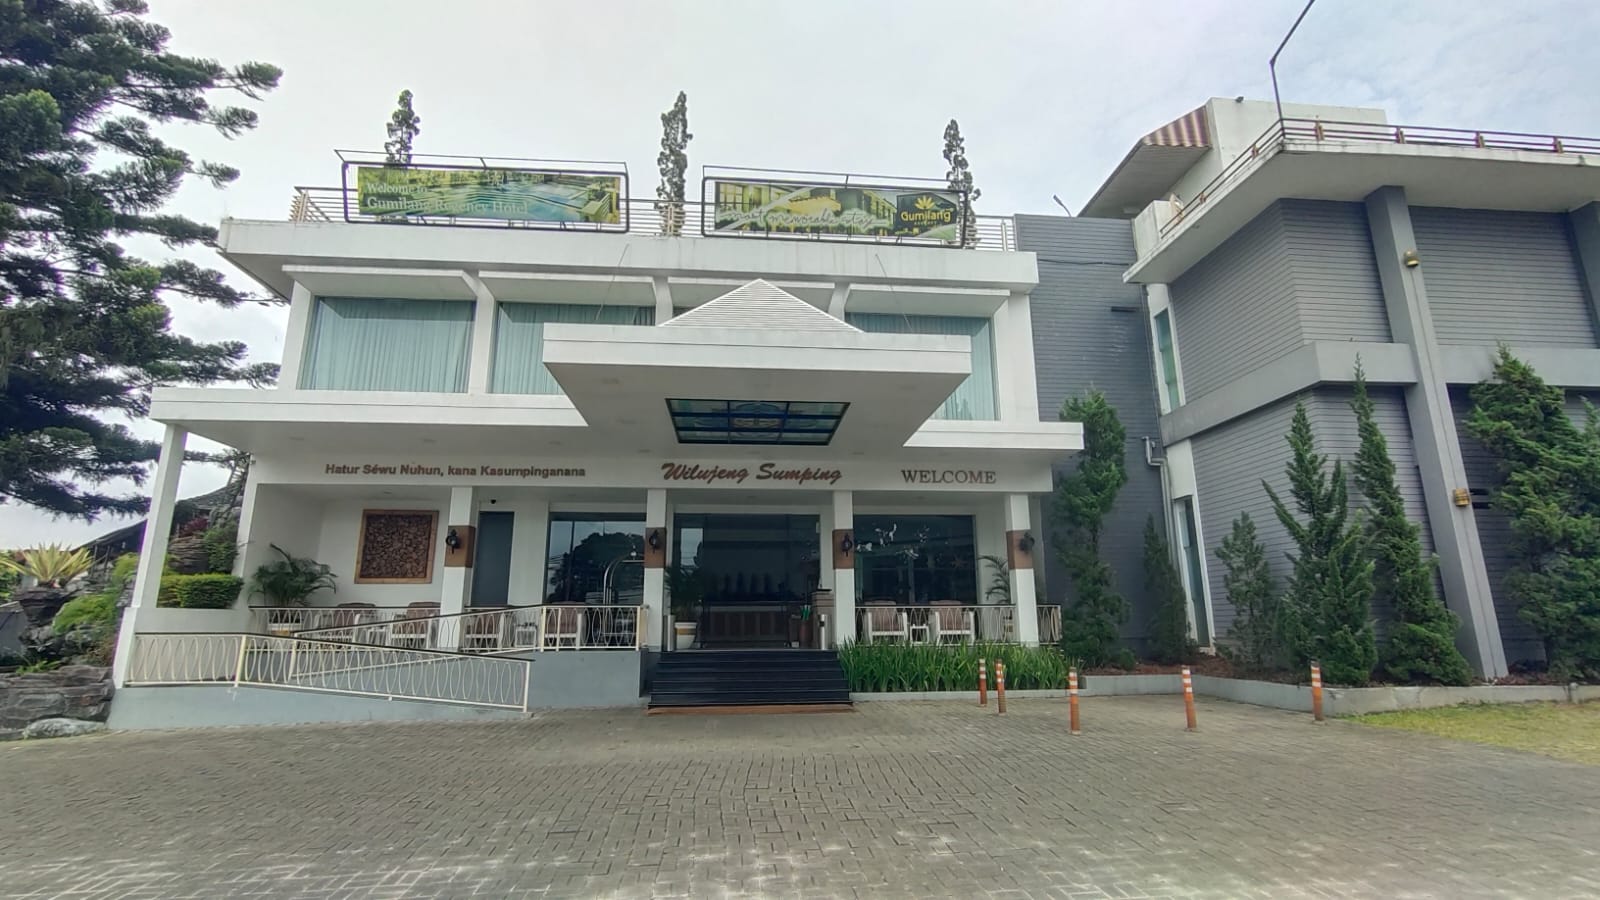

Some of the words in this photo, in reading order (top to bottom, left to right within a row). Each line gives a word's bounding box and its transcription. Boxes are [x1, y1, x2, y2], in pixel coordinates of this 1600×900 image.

[367, 183, 414, 194] Welcome
[416, 184, 428, 194] to
[367, 197, 430, 213] Gumilang
[493, 201, 528, 214] Hotel
[900, 209, 951, 222] Gumilang
[325, 464, 360, 475] Hatur
[362, 464, 397, 475] Séwu
[400, 464, 444, 477] Nuhun,
[447, 465, 477, 476] kana
[480, 465, 586, 479] Kasumpinganana
[661, 462, 749, 484] Wilujeng
[755, 463, 842, 485] Sumping
[901, 469, 996, 484] WELCOME
